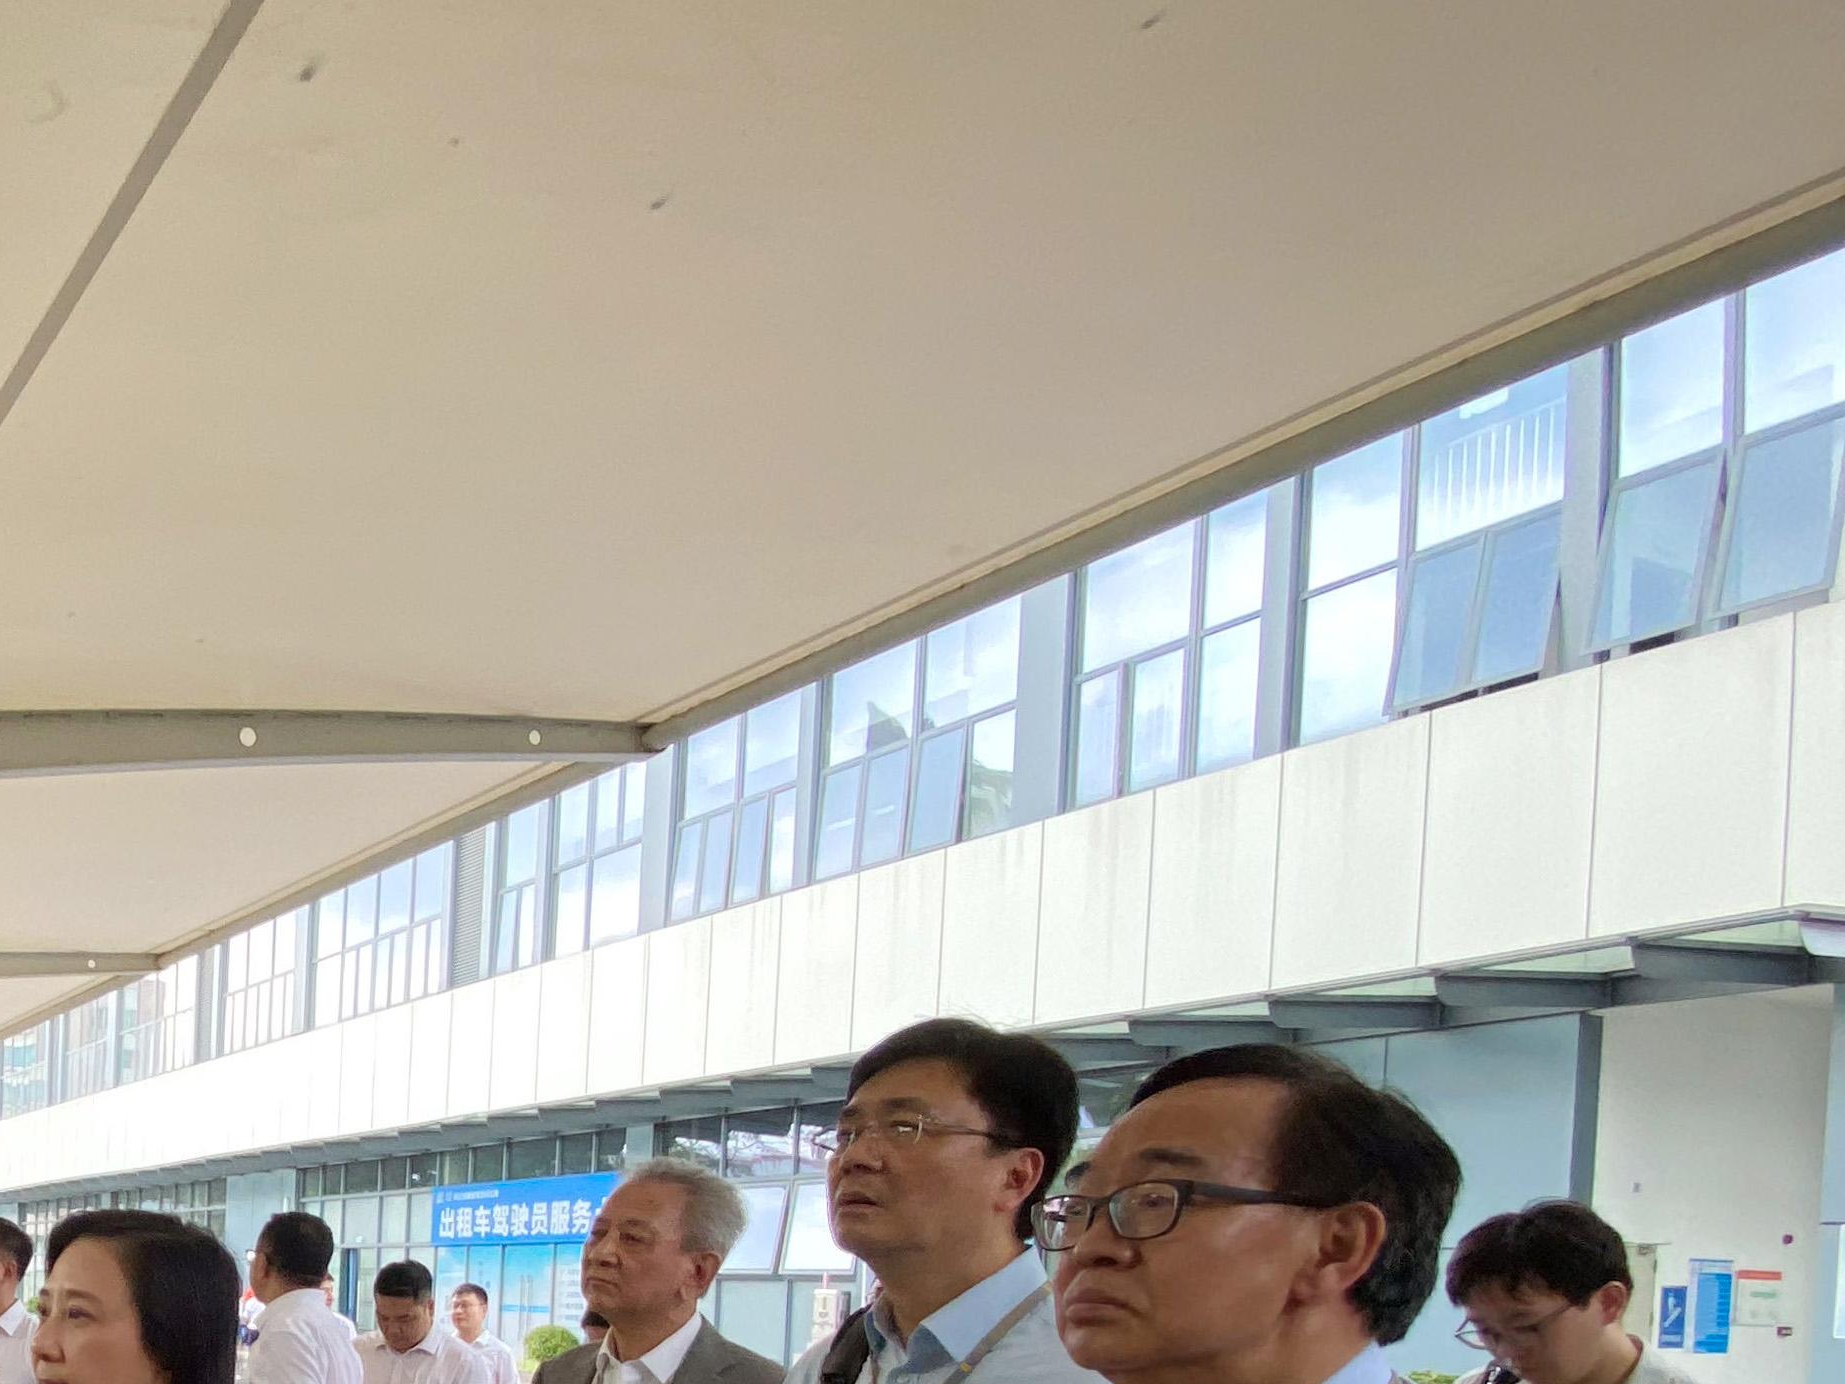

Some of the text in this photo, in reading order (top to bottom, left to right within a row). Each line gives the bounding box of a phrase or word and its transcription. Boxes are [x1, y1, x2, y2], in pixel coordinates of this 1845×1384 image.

[438, 1196, 606, 1240] 出租车驾驶员服务
